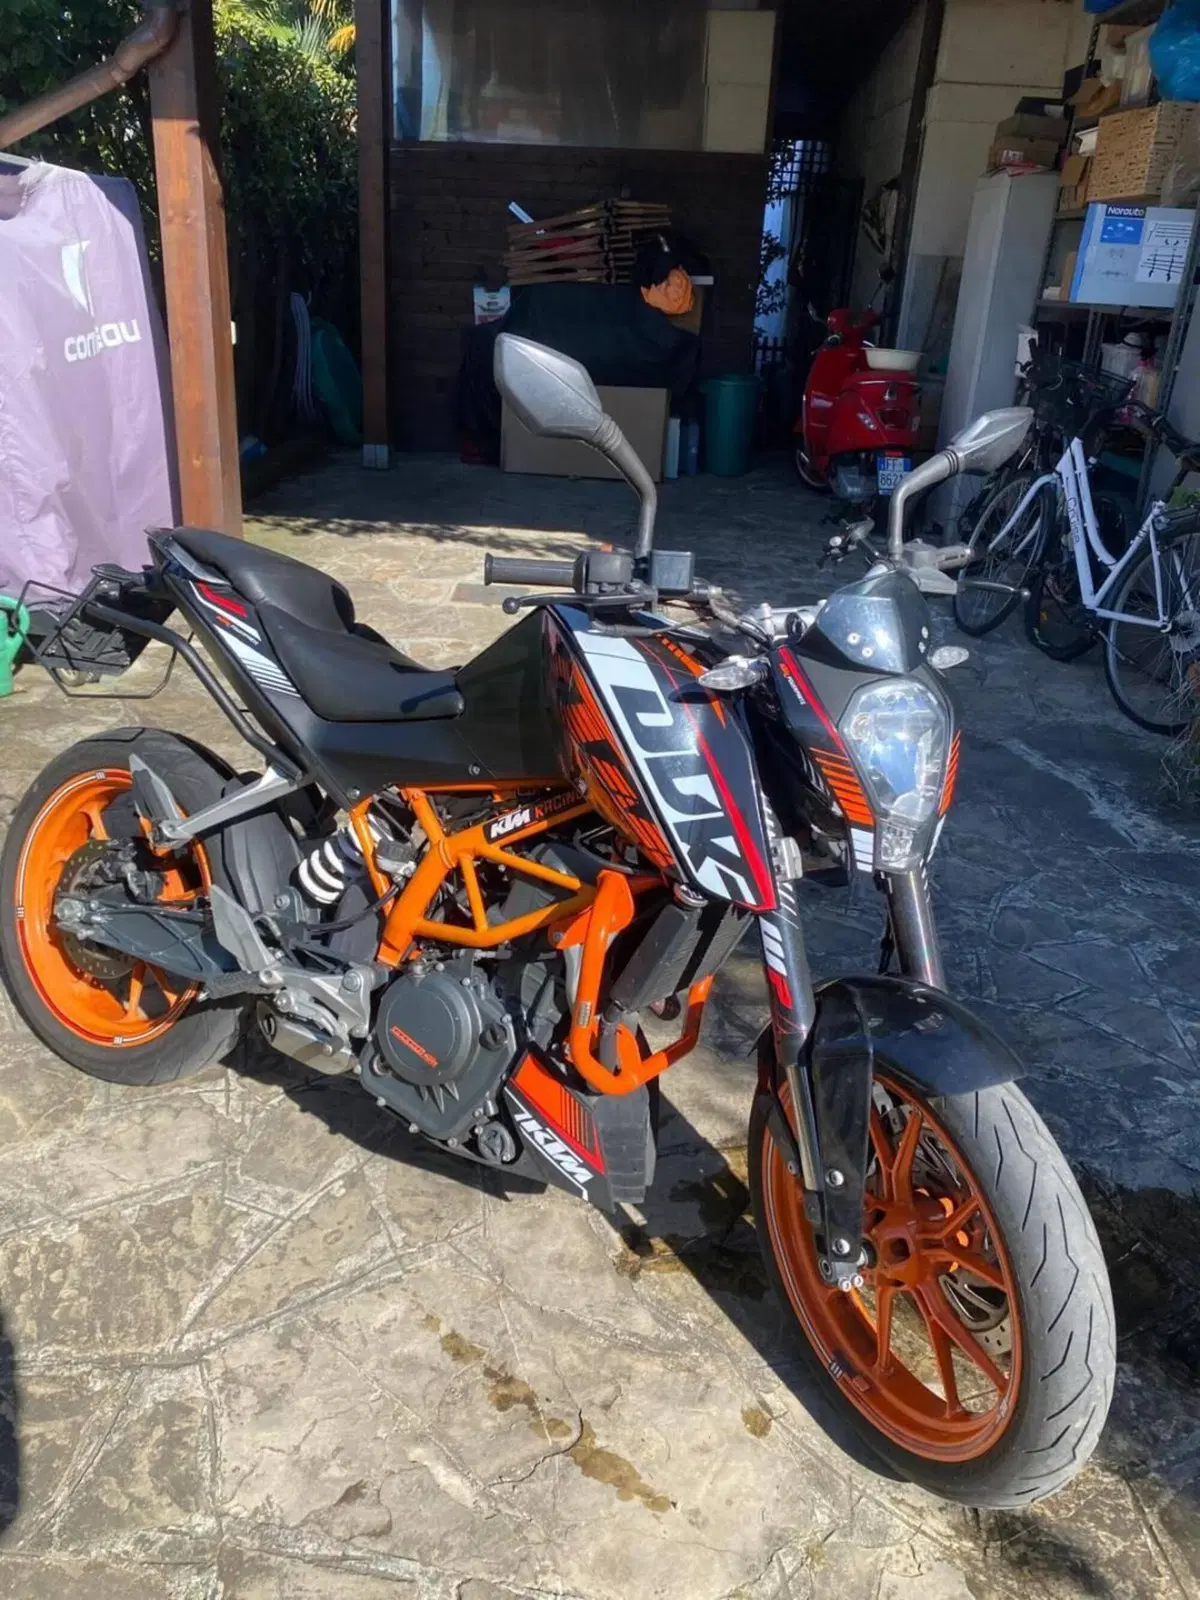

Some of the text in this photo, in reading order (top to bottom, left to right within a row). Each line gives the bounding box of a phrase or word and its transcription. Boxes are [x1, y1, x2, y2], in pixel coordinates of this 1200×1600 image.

[1107, 206, 1145, 216] Norauto
[490, 808, 531, 839] KTM
[520, 1119, 594, 1184] KTM
